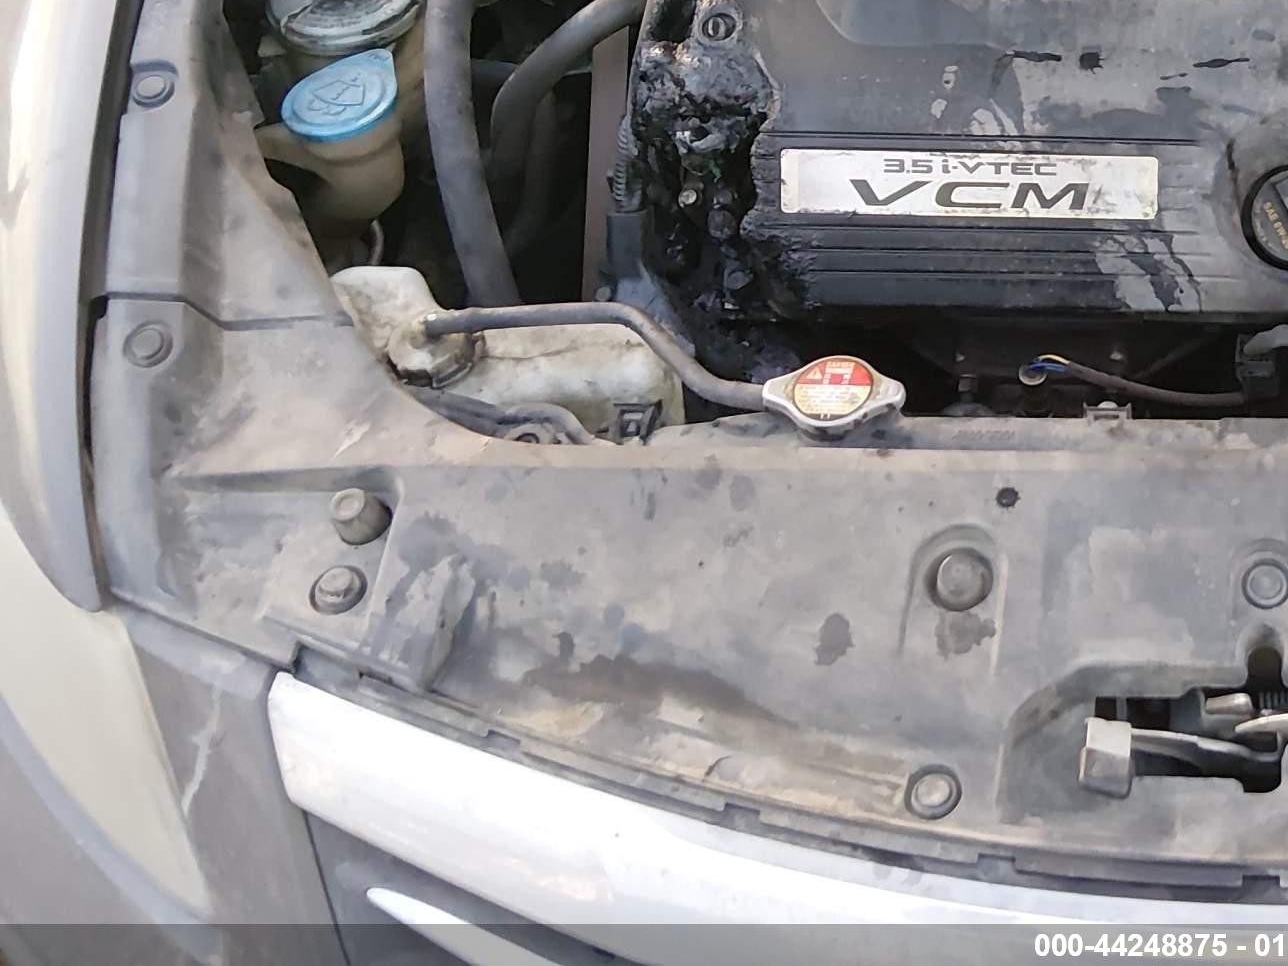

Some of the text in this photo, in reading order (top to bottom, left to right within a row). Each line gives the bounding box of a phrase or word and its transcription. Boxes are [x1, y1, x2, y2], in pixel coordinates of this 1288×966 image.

[883, 158, 1058, 176] 3.5 i-VTEC
[849, 179, 1089, 211] VCM
